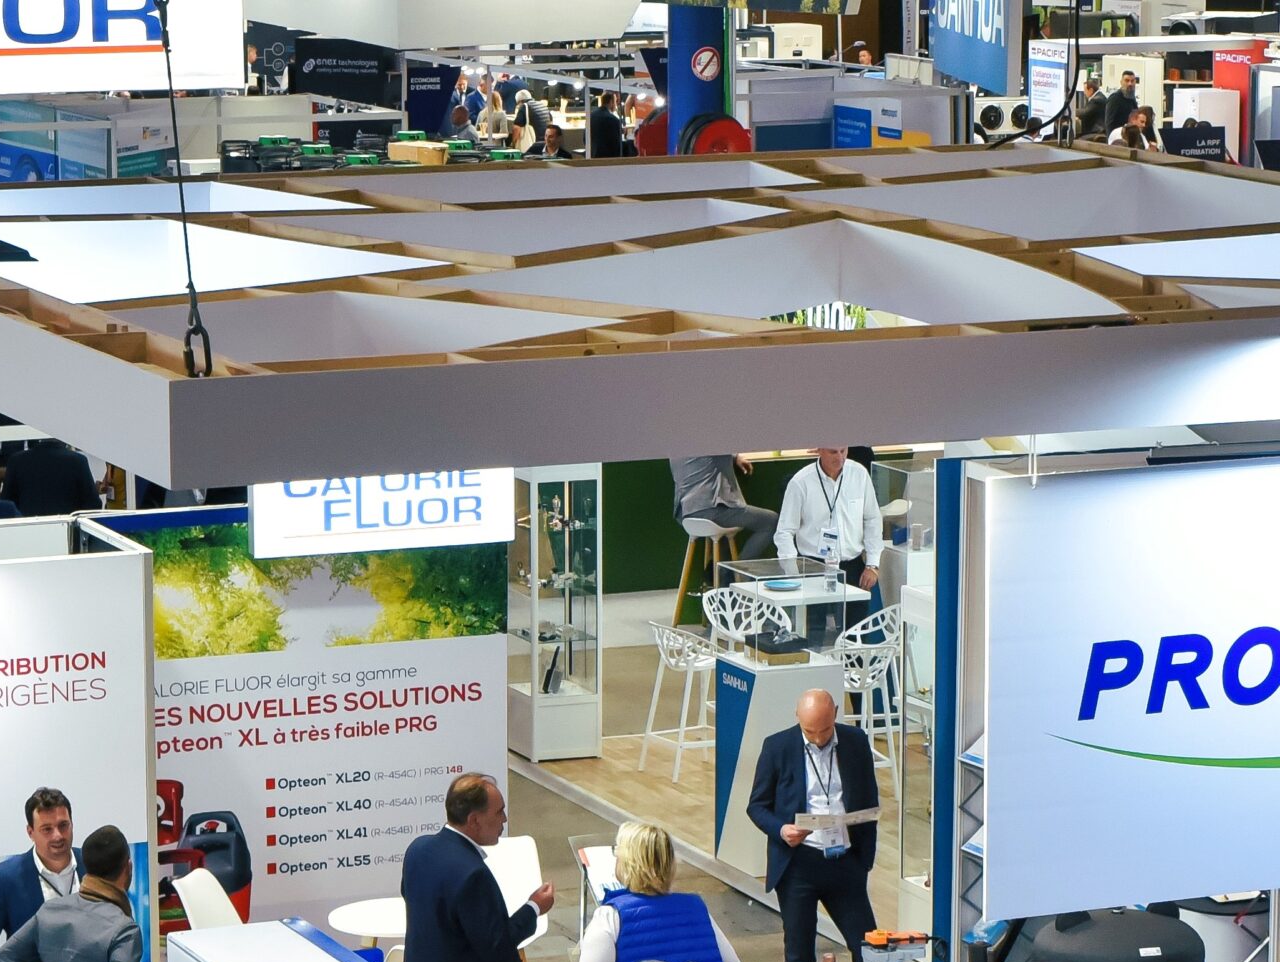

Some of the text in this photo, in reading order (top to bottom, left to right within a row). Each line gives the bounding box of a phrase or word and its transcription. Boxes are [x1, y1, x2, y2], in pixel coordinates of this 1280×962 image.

[1036, 48, 1066, 59] PACIFIC
[1221, 53, 1252, 64] PACIFIC
[338, 59, 378, 67] technologies
[1180, 147, 1221, 156] FORMATION
[1196, 139, 1207, 147] LA
[324, 496, 482, 531] FLUOR
[215, 675, 271, 693] FLUOR
[276, 672, 326, 691] élargit
[332, 672, 351, 684] sa
[356, 667, 417, 686] gamme
[722, 672, 748, 693] SANHUA
[155, 682, 483, 727] ES NOUVELLES SOLUTIONS
[238, 728, 268, 747] XL
[274, 728, 286, 744] à
[290, 722, 330, 742] très
[335, 718, 390, 740] faible
[395, 716, 438, 735] PRG
[336, 771, 371, 784] XL20
[374, 769, 417, 781] (R-454C)
[424, 767, 444, 776] PRG
[446, 765, 463, 774] 148
[336, 798, 372, 812] XL40
[375, 797, 418, 809] (R-454A)
[425, 795, 445, 803] PRG
[336, 827, 368, 840] XL41
[371, 825, 413, 837] (R-454B)
[420, 823, 441, 832] PRG
[336, 855, 371, 868] XL55
